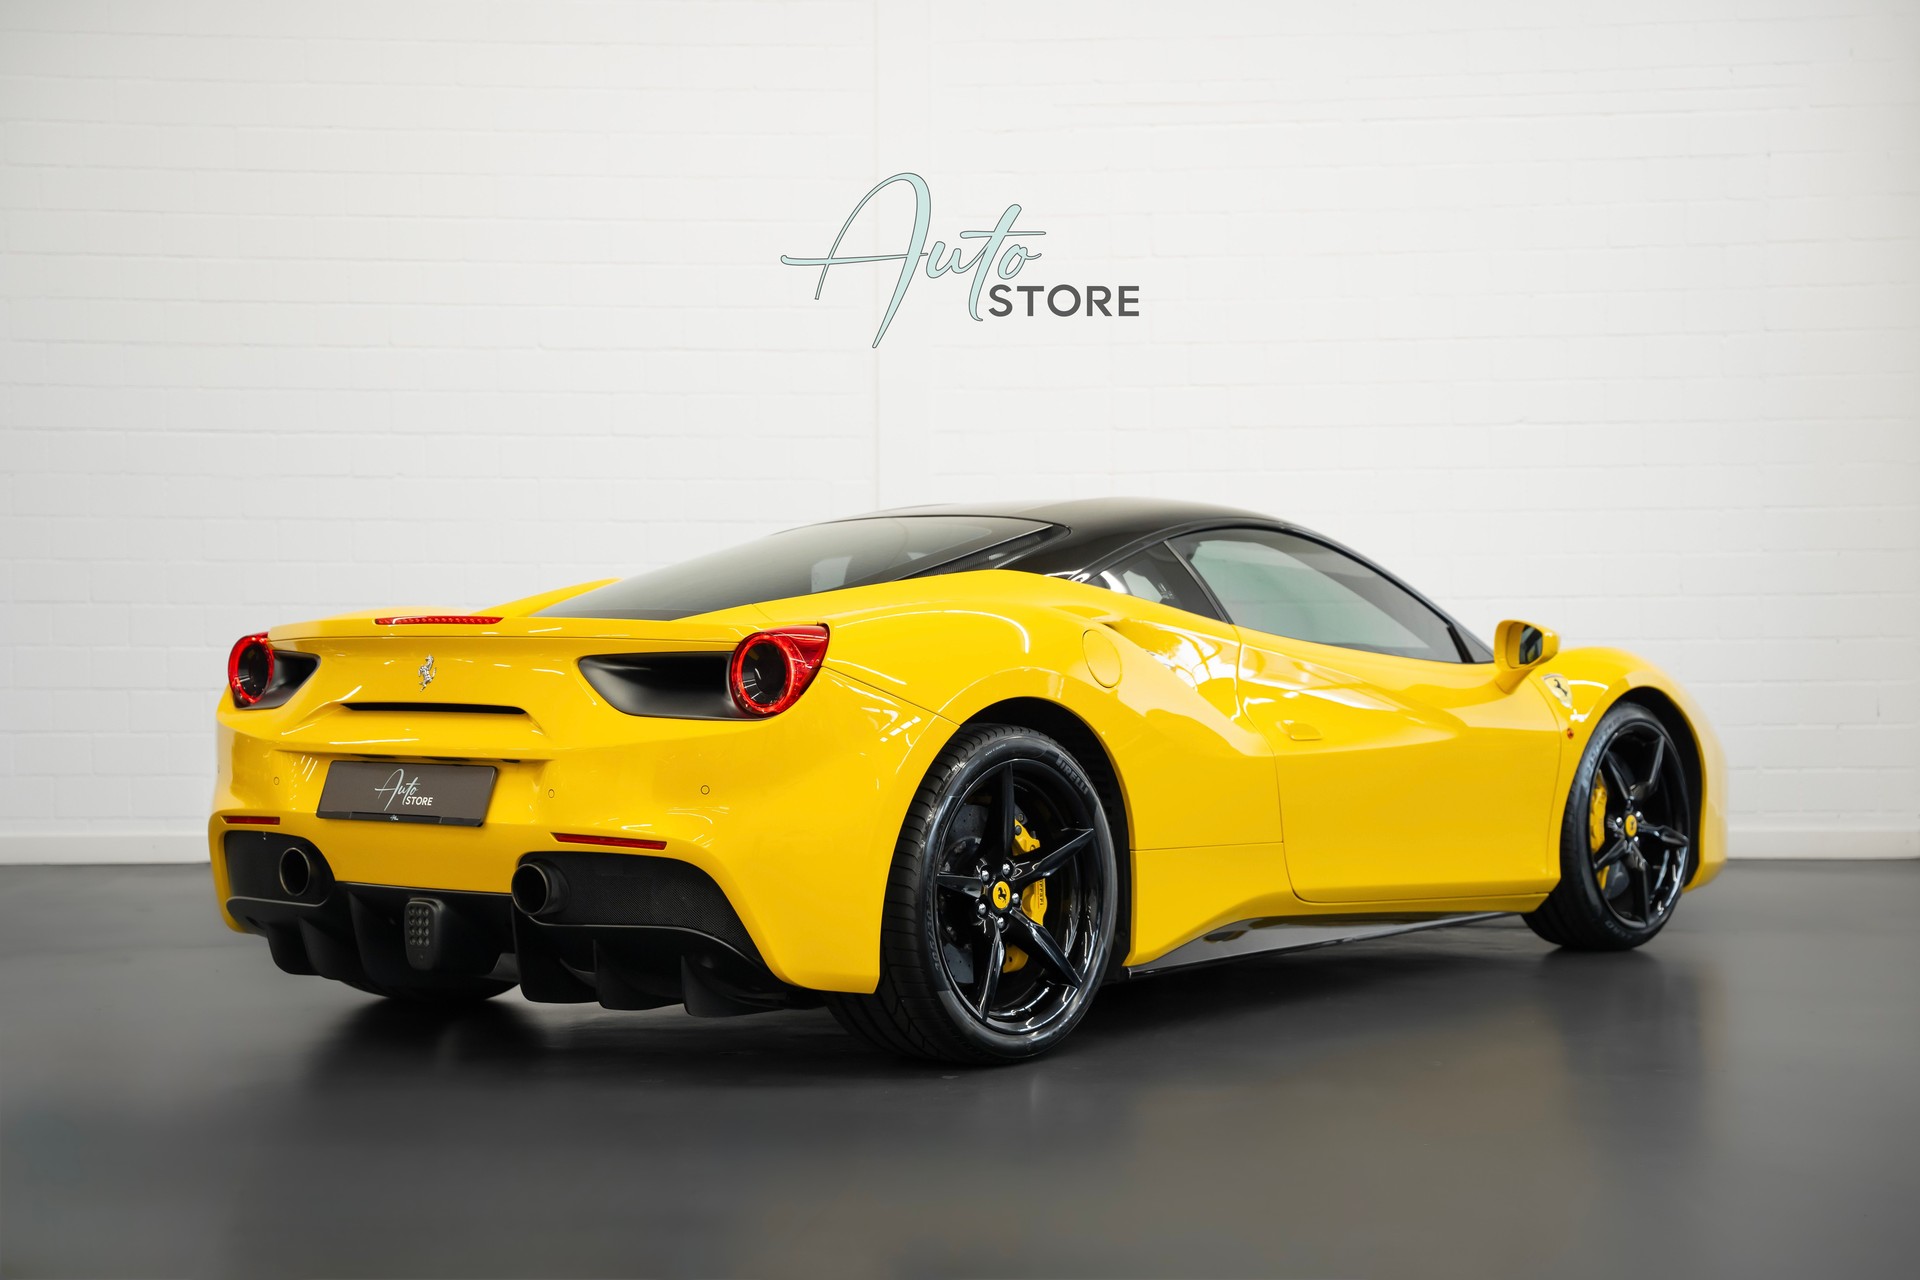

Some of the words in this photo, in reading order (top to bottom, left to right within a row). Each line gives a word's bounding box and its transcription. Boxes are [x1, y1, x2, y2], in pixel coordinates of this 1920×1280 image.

[780, 172, 1047, 349] Auto
[988, 283, 1140, 318] STORE
[374, 768, 421, 811] Auto
[405, 796, 433, 805] STORE
